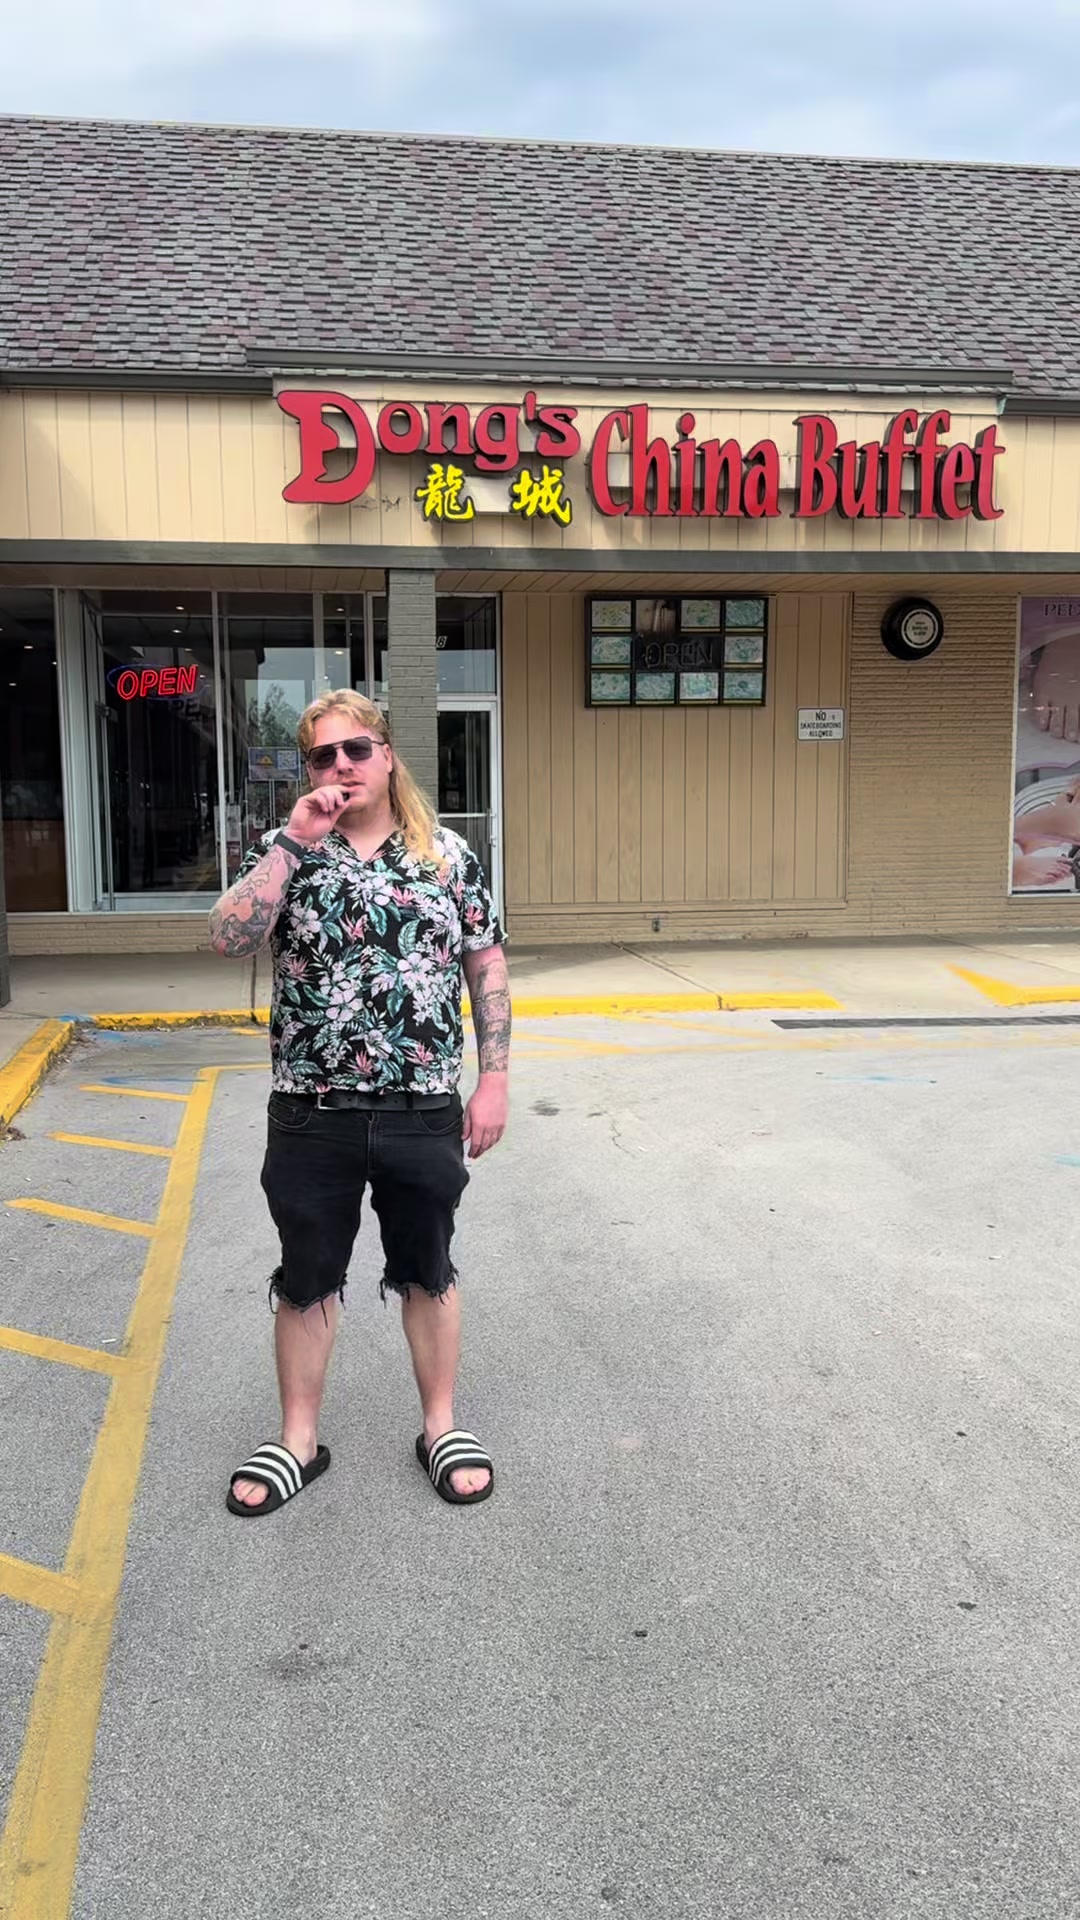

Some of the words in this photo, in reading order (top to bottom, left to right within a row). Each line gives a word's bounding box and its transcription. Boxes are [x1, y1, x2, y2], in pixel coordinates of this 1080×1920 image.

[277, 389, 581, 504] Dong's
[588, 403, 781, 518] China
[793, 408, 1006, 521] Buffet
[416, 463, 573, 526] 龍城
[645, 641, 713, 667] OPEN
[116, 664, 198, 700] OPEN
[815, 711, 827, 721] NO
